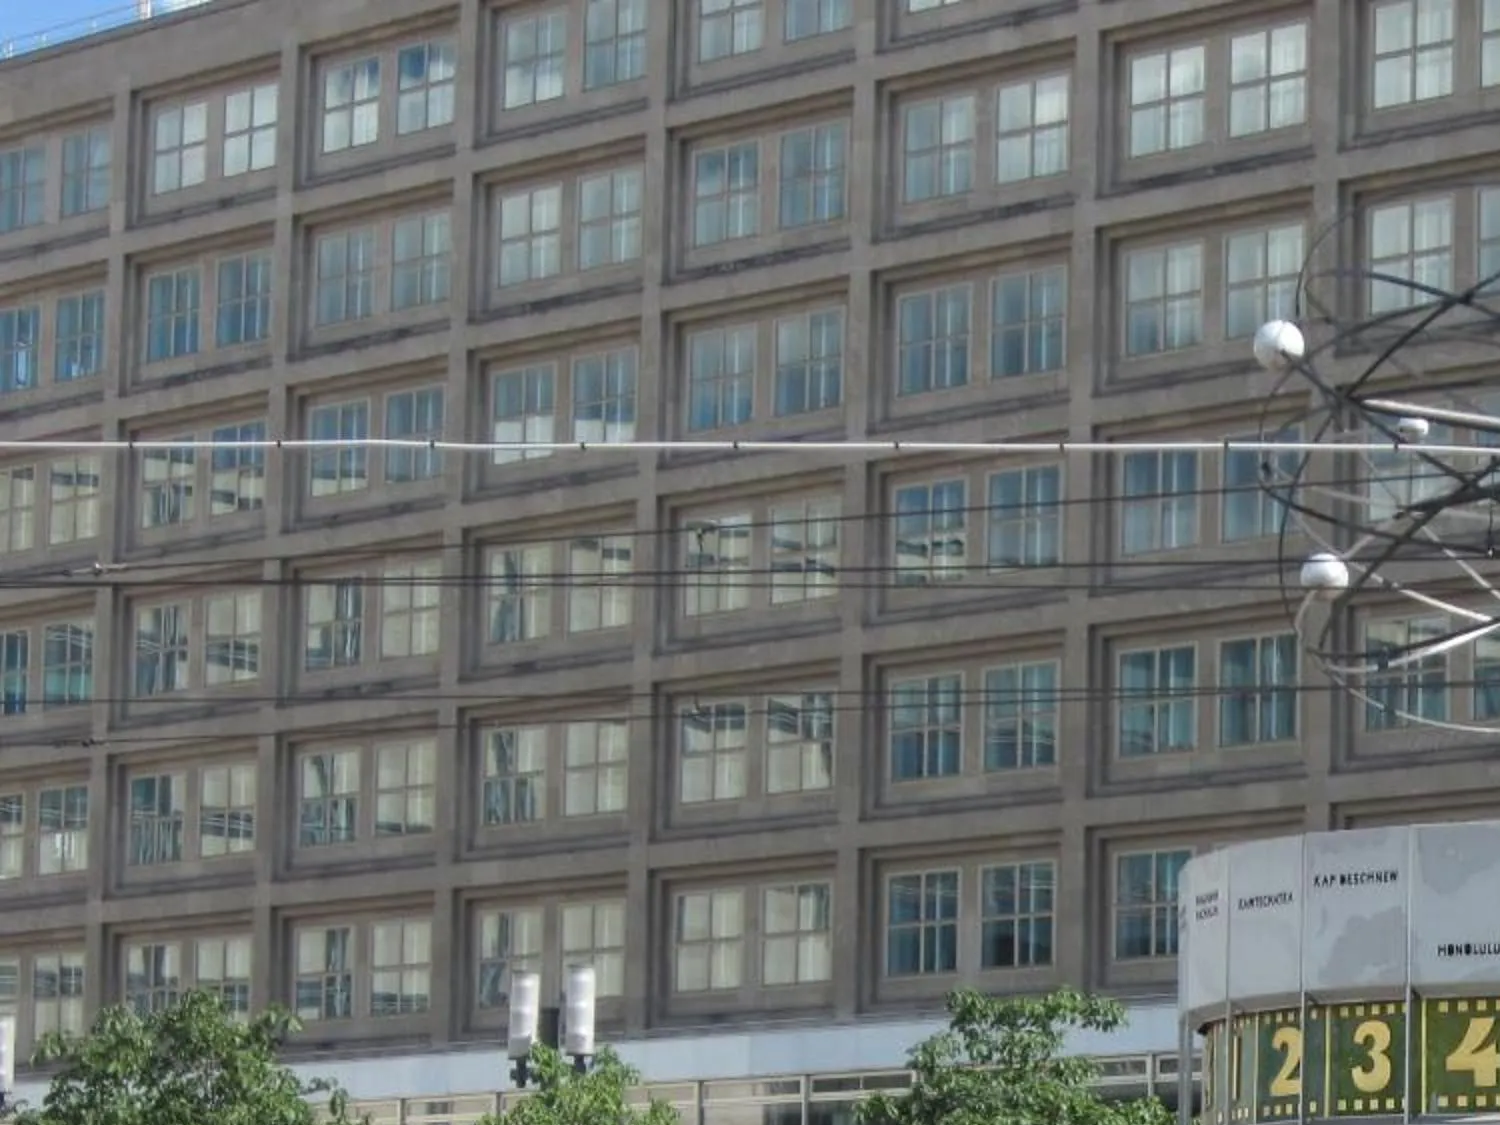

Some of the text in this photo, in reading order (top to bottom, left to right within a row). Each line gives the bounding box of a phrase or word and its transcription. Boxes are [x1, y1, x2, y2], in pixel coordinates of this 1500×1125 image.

[1314, 870, 1399, 887] KAP DESCHNEW
[1437, 943, 1500, 957] HONOLULU
[1269, 1026, 1302, 1097] 2
[1351, 1020, 1391, 1093] 3
